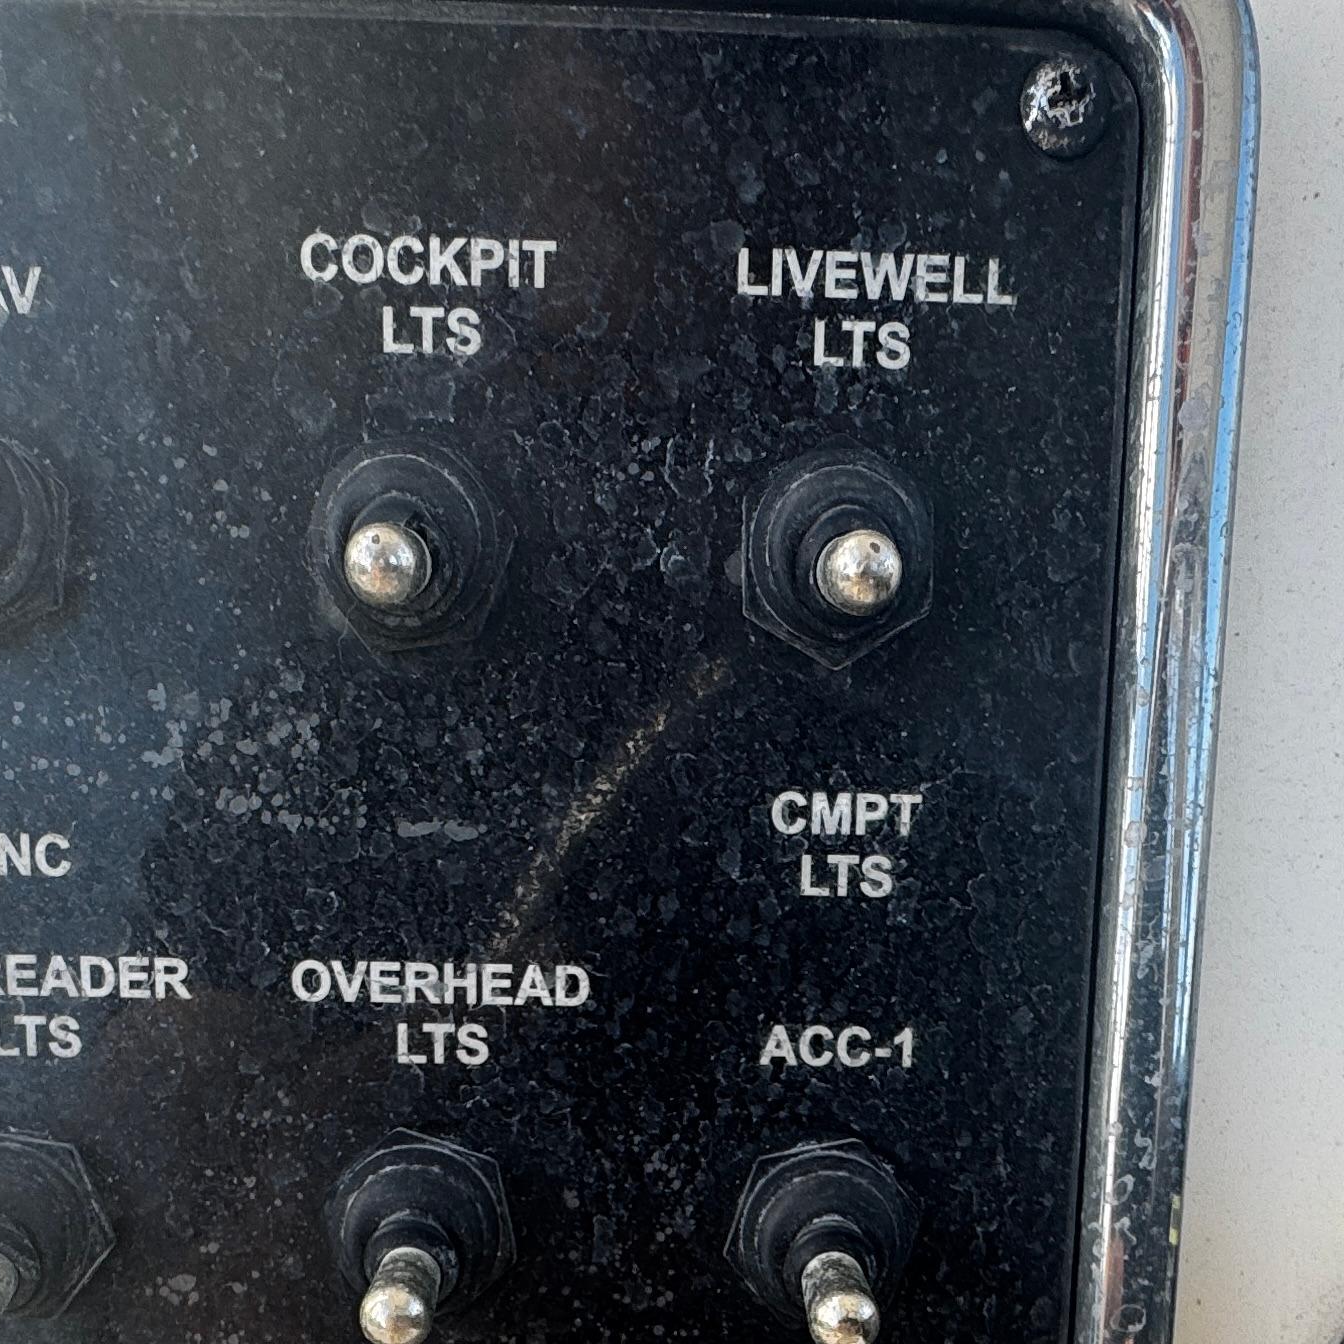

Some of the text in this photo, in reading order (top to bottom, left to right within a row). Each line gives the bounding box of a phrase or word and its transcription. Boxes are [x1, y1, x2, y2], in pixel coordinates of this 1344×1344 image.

[300, 234, 557, 289] COCKPIT
[737, 247, 1017, 306] LIVEWELL
[382, 306, 482, 355] LTS
[813, 320, 911, 370] LTS
[771, 790, 923, 836] CMPT
[800, 854, 893, 898] LTS
[291, 960, 591, 1007] OVERHEAD
[396, 1022, 490, 1065] LTS
[759, 1024, 914, 1068] ACC-1
